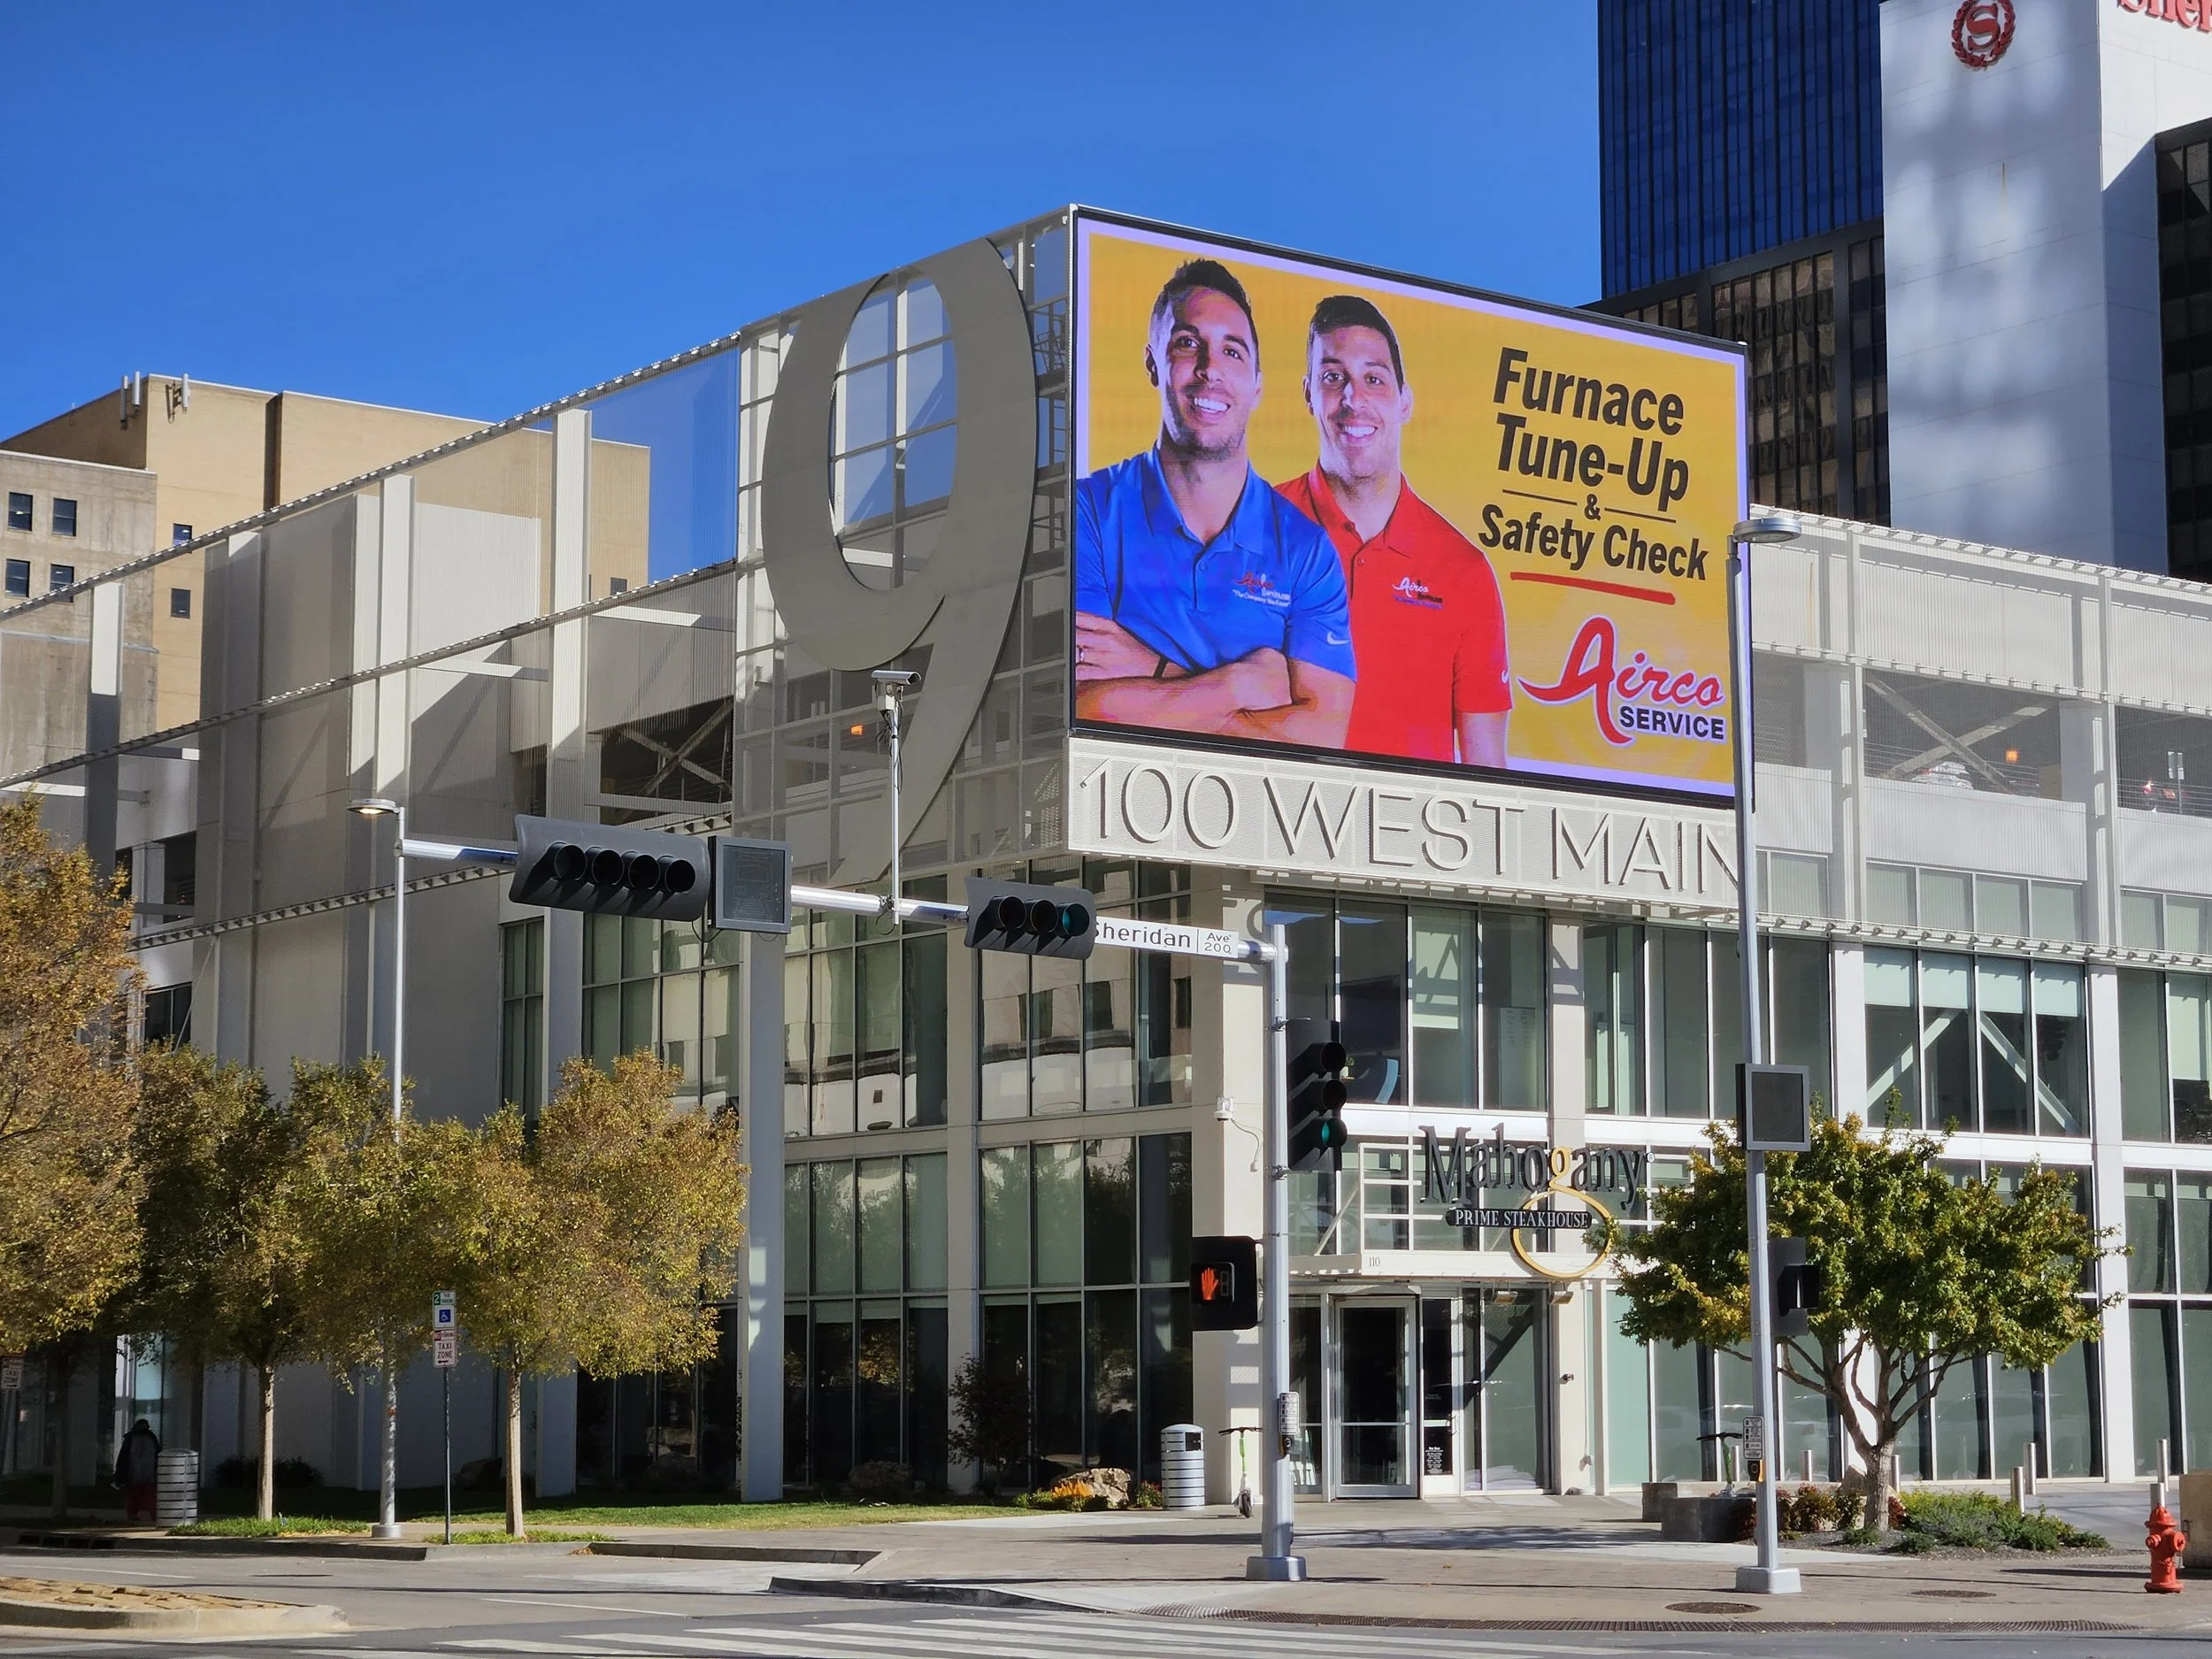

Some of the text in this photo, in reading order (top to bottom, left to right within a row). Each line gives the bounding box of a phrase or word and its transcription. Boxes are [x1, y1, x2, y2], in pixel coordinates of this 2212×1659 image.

[1493, 346, 1684, 435] Furnace
[1496, 412, 1689, 512] Tune-Up
[1584, 493, 1601, 521] &
[1478, 503, 1709, 580] Safety Check
[1517, 617, 1724, 744] Airco
[1619, 706, 1724, 740] SERVICE
[1079, 757, 1739, 894] 100 WEST MAIN
[1204, 941, 1232, 954] 200
[1206, 932, 1231, 942] Ave
[1418, 1123, 1644, 1278] Mahogany
[1455, 1209, 1589, 1228] PRIME STEAKHOUSE
[1369, 1256, 1380, 1267] 110
[434, 1294, 440, 1303] 2
[437, 1350, 453, 1359] ZONE
